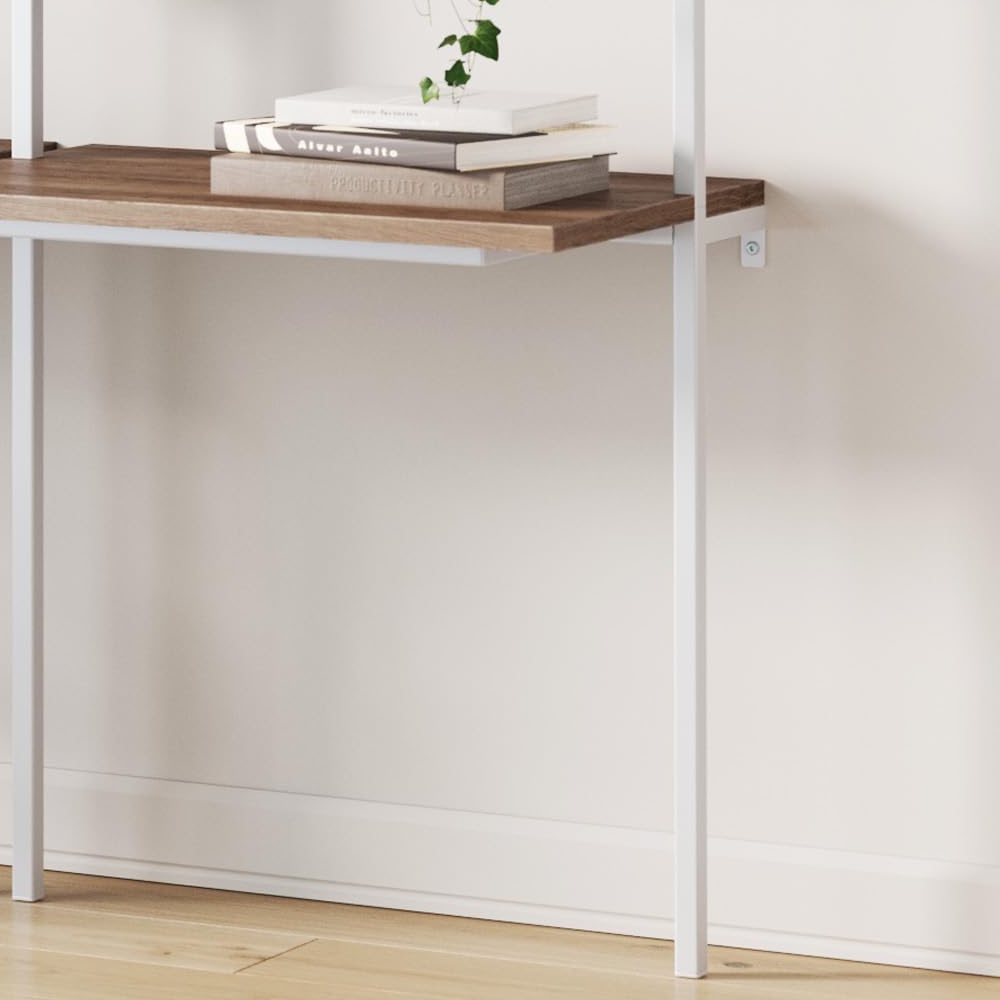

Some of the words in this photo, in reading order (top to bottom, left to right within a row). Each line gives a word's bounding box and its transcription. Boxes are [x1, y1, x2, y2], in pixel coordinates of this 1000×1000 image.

[298, 139, 344, 153] Alvar
[352, 144, 399, 158] Aalto
[329, 175, 424, 196] PRODUCTIVITY
[431, 181, 489, 199] PLANNER
